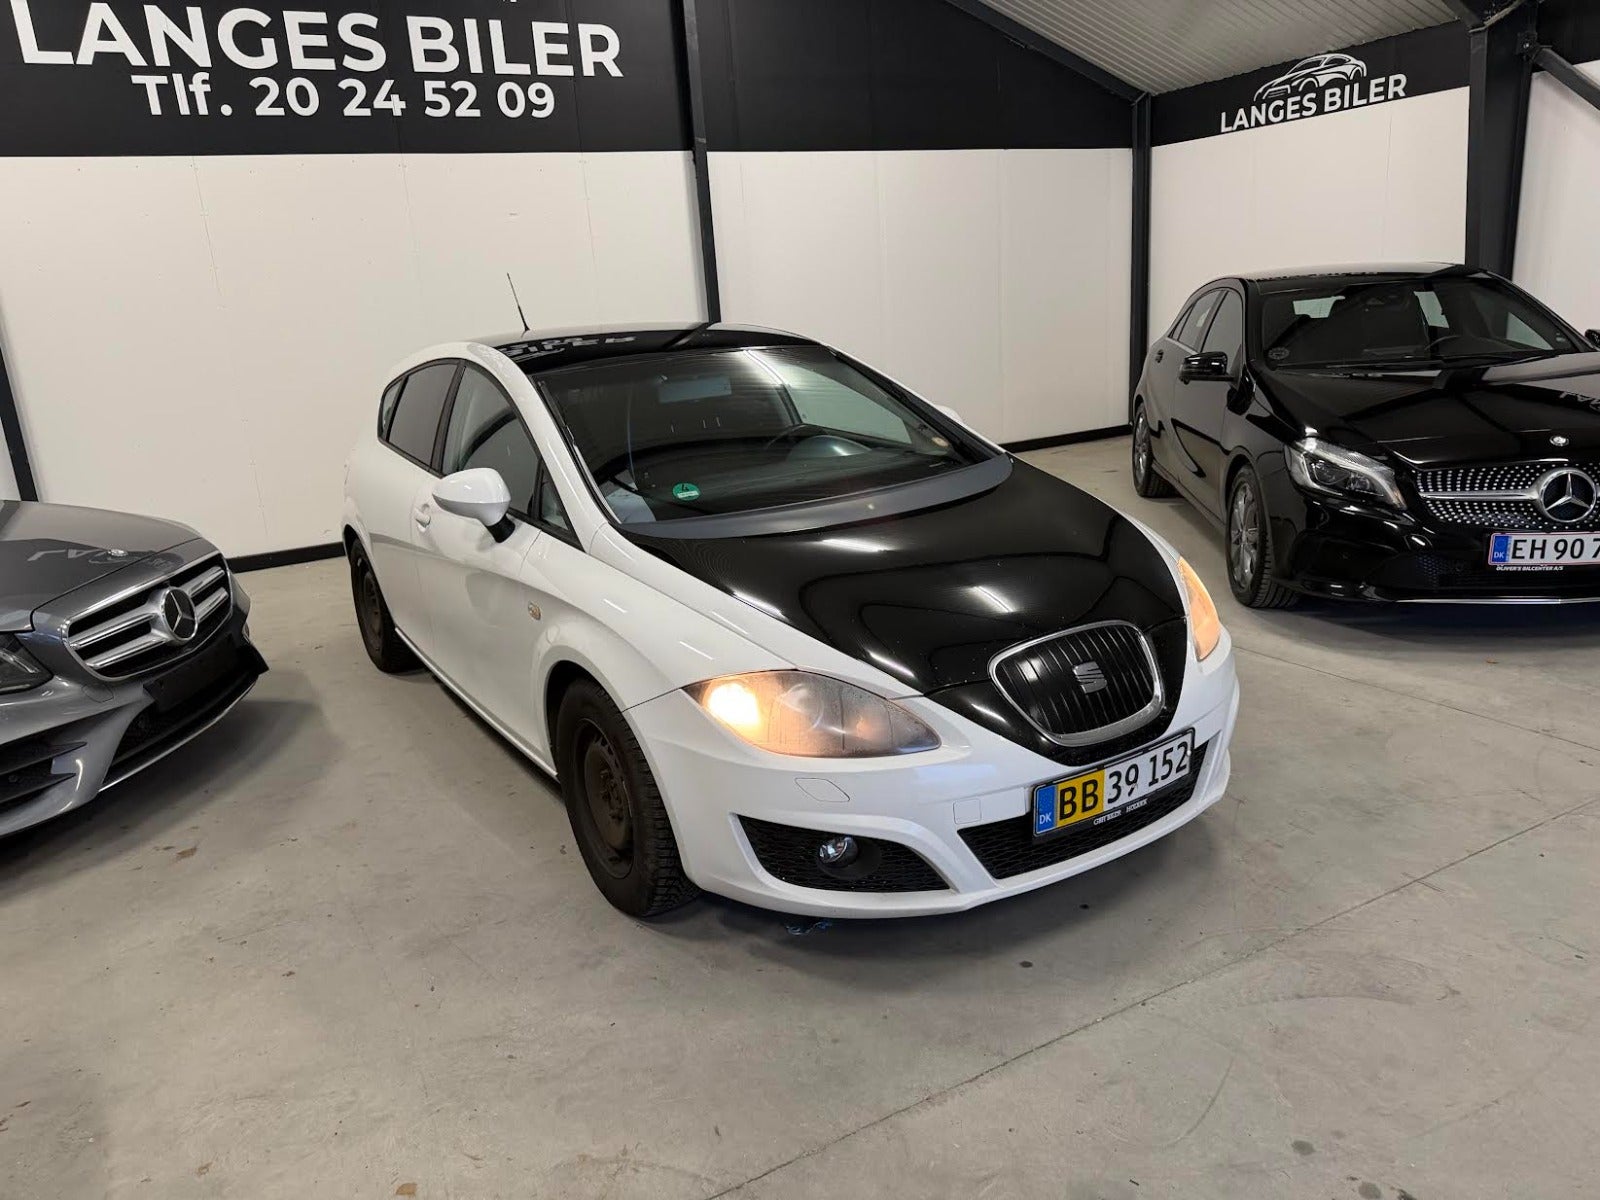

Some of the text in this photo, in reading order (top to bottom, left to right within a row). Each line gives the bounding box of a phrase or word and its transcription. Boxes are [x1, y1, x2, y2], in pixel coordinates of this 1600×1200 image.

[11, 0, 624, 78] LANGES BILER
[131, 71, 555, 118] Tlf. 20 24 52 09
[1220, 73, 1408, 134] LANGES BILER
[1494, 551, 1504, 559] DK
[1511, 539, 1547, 560] EH
[1553, 538, 1585, 560] 90
[1059, 779, 1099, 820] BB
[1107, 763, 1139, 804] 39
[1148, 741, 1189, 787] 152
[1039, 812, 1051, 825] DK
